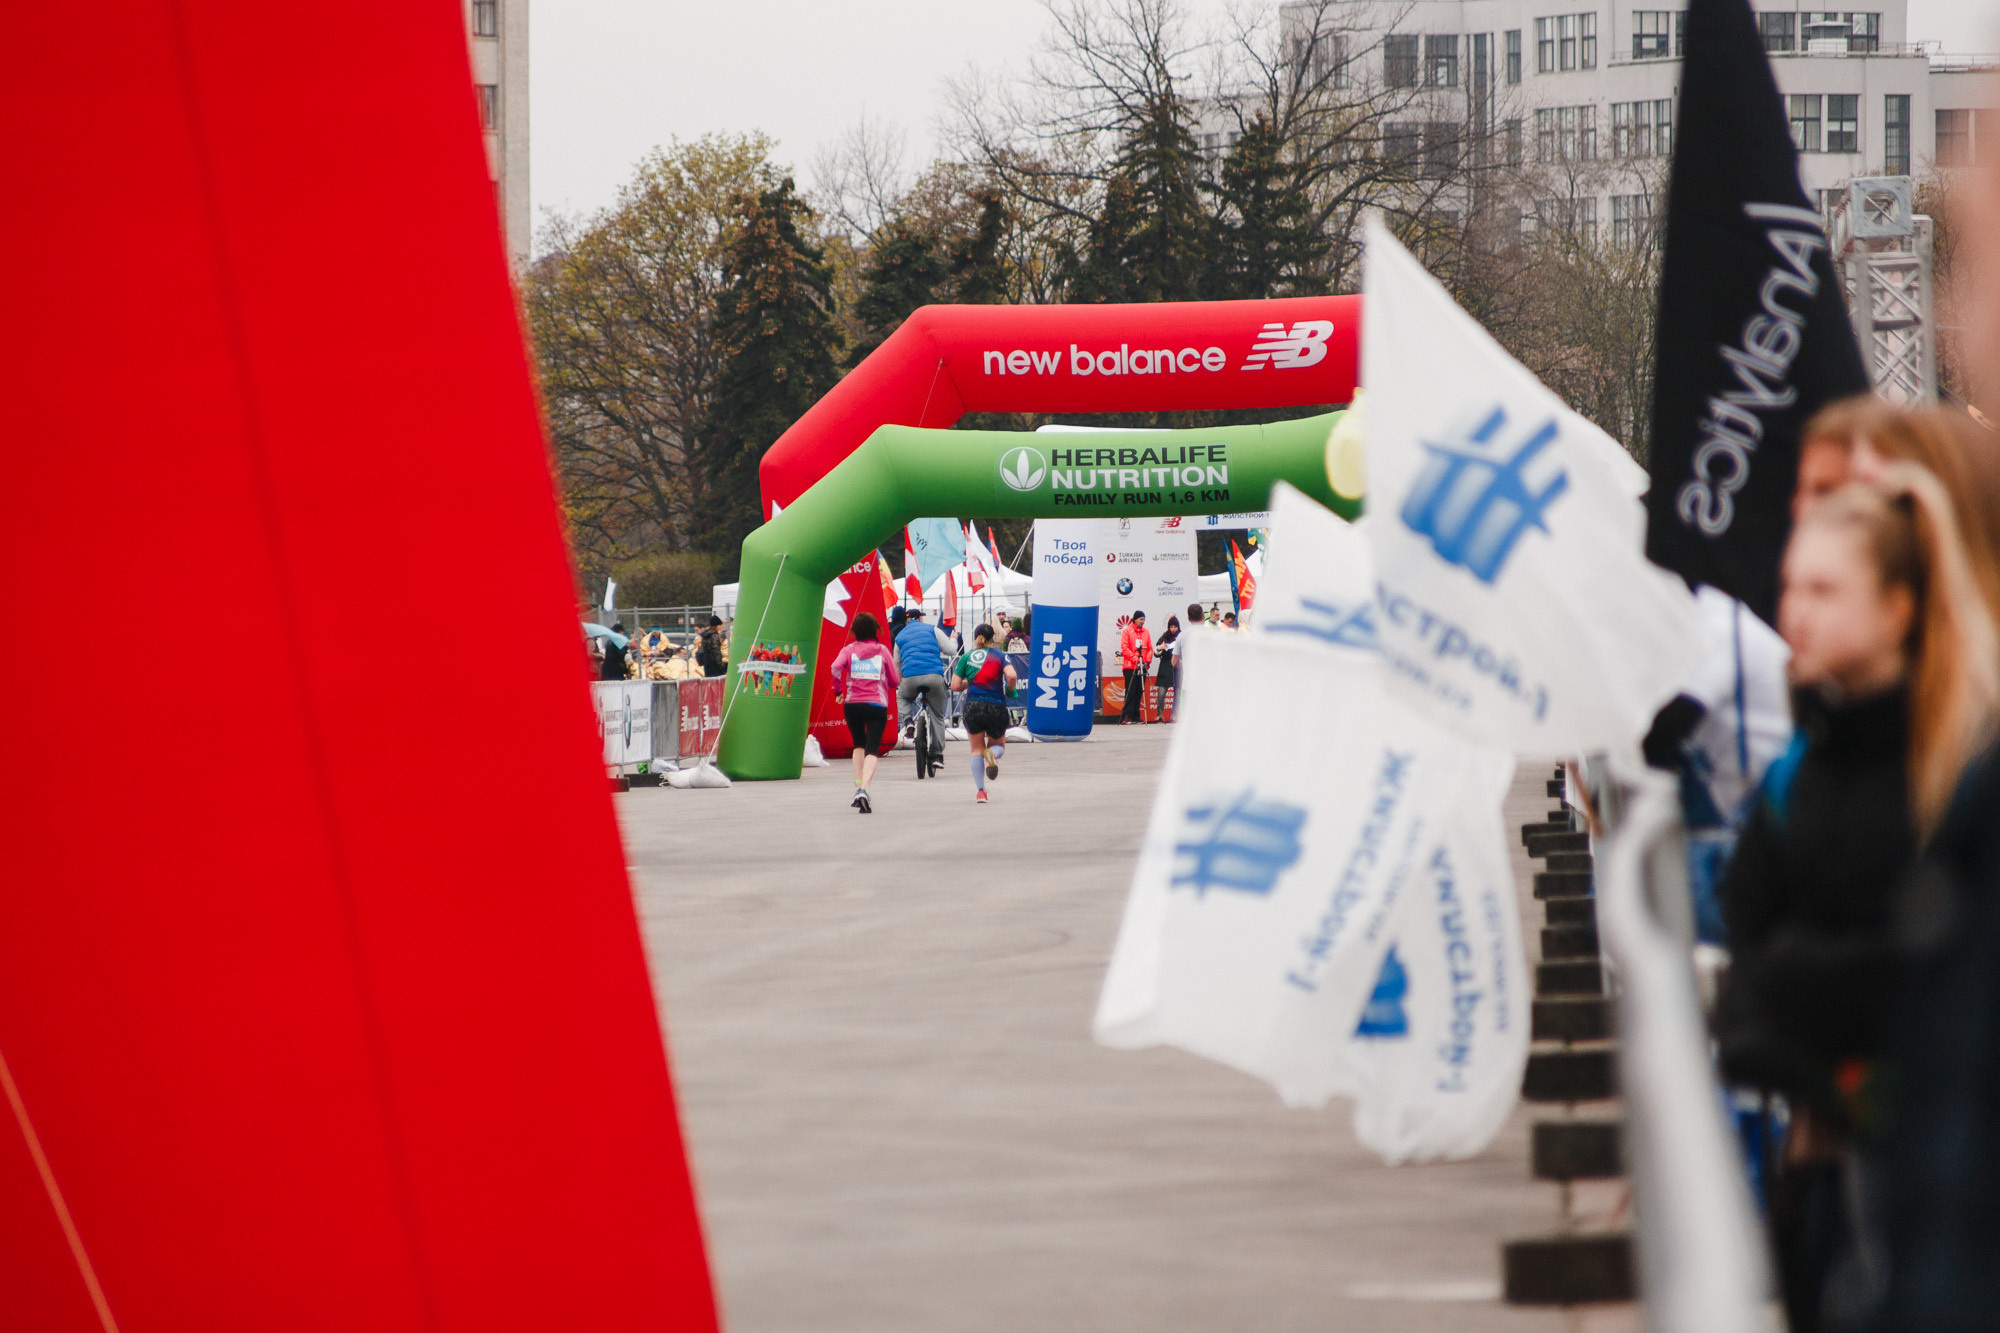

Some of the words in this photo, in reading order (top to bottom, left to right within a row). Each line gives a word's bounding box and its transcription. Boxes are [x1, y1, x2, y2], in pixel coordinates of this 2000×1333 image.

[983, 349, 1062, 376] new
[1070, 343, 1227, 376] balance
[1051, 445, 1227, 466] HERBALIFE
[1051, 465, 1229, 489] NUTRITION
[1054, 493, 1117, 505] FAMILY
[1124, 492, 1161, 505] RUN
[1168, 491, 1195, 505] 1,6
[1201, 489, 1230, 502] KM
[1053, 538, 1086, 550] Твоя
[1044, 553, 1093, 565] победа
[1035, 632, 1063, 709] Меч
